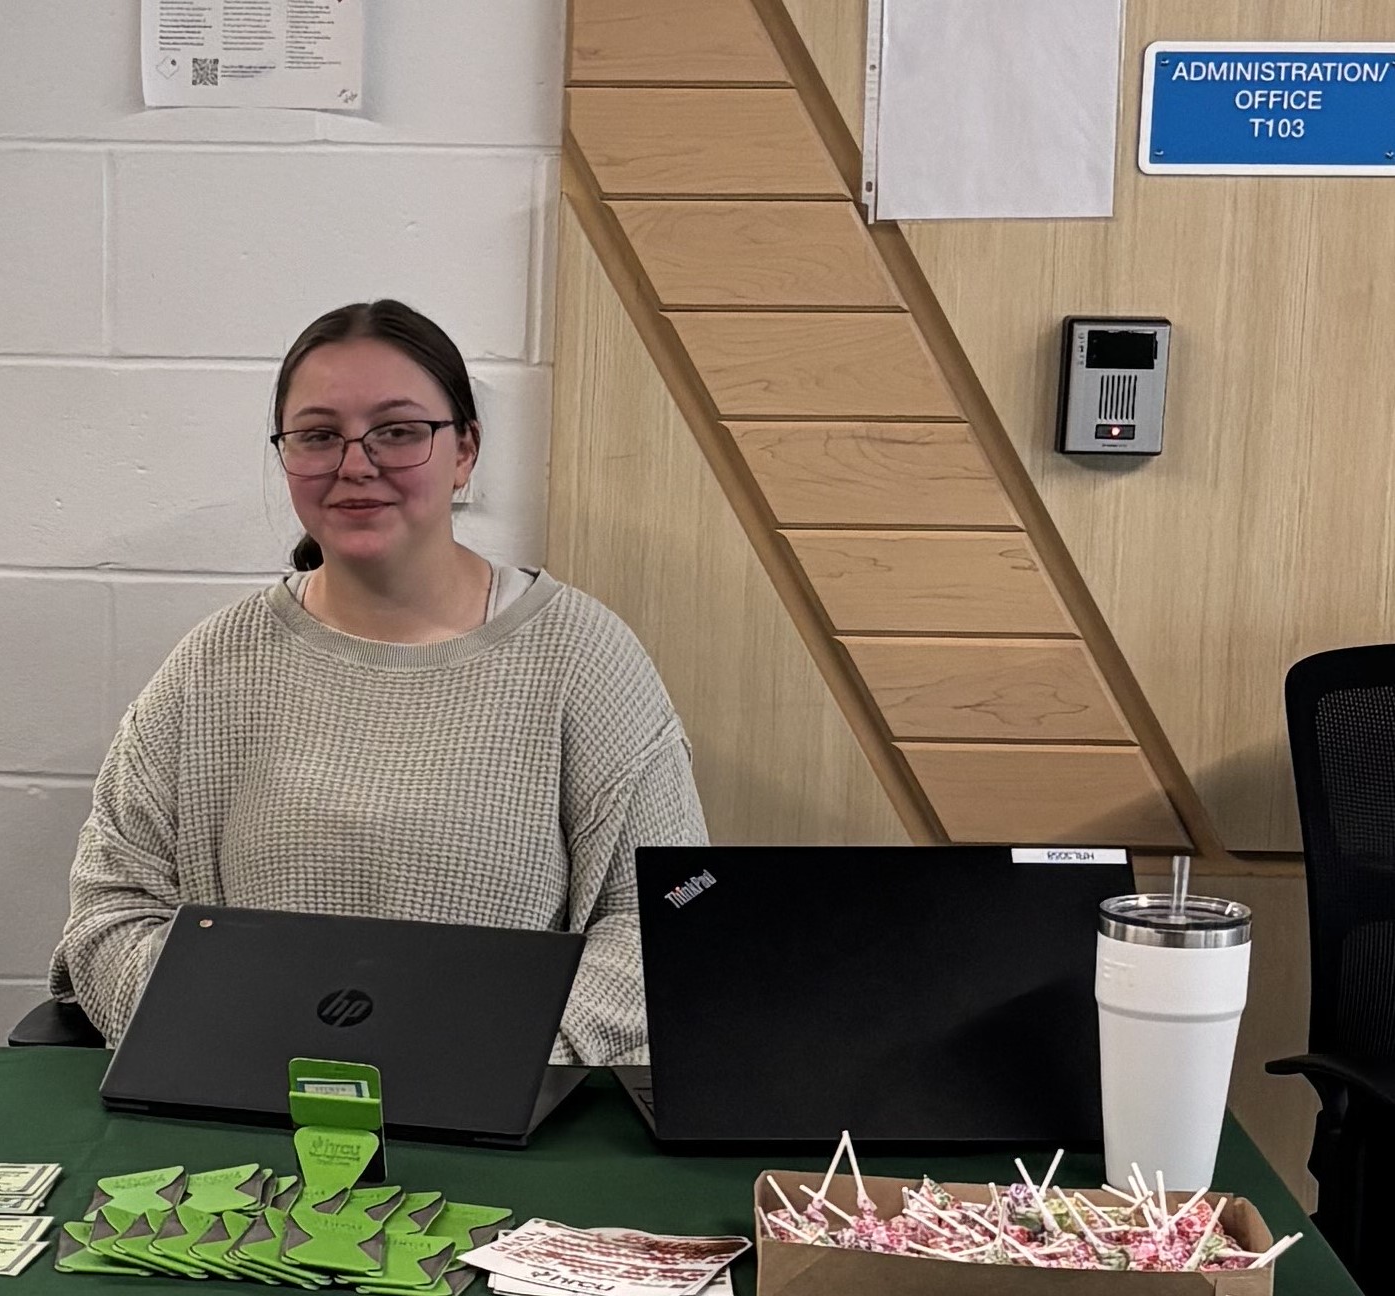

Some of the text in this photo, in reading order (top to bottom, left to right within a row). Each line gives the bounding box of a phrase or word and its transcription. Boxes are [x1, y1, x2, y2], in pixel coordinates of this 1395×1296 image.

[1171, 61, 1390, 83] ADMINISTRATION/
[1233, 89, 1323, 110] OFFICE
[1248, 117, 1305, 138] T103
[664, 868, 717, 909] ThinkPad
[319, 988, 371, 1028] hp
